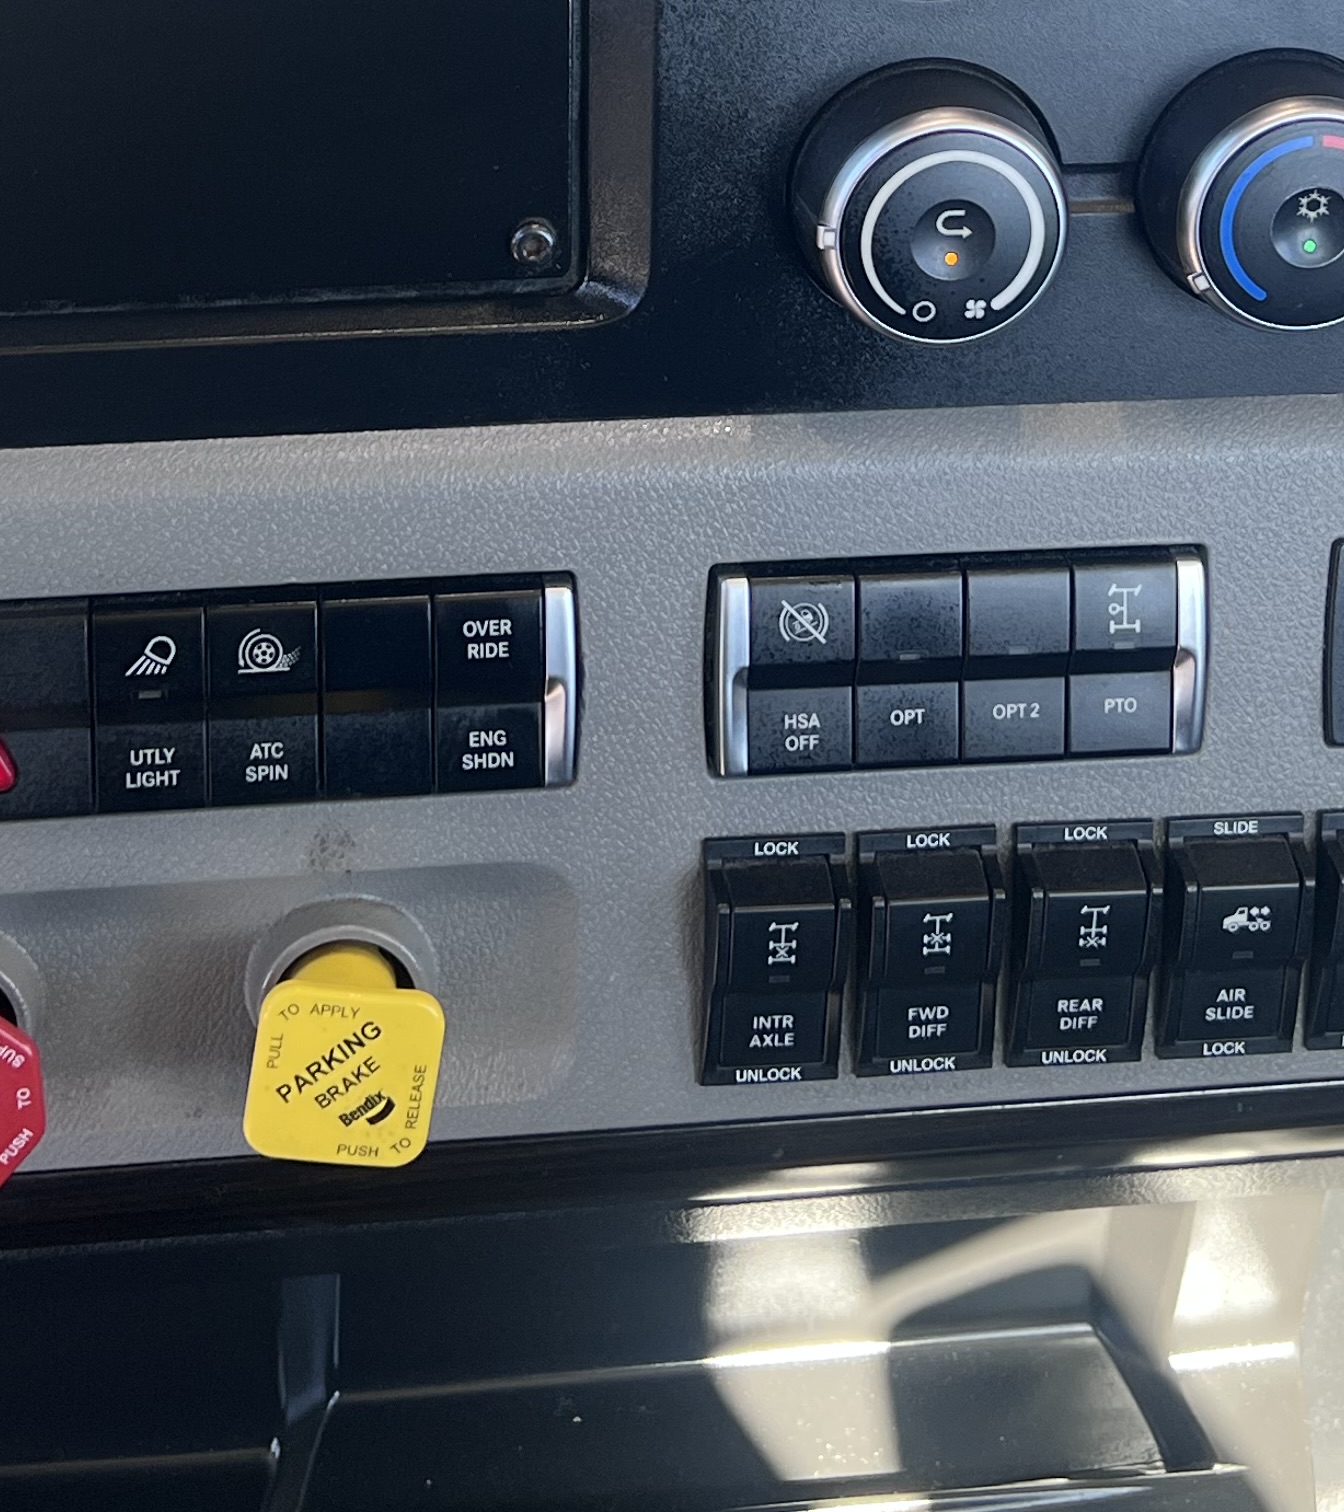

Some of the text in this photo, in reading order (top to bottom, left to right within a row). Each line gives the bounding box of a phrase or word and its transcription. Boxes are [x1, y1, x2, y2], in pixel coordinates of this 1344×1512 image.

[462, 619, 512, 638] OVER
[466, 641, 509, 660] RIDE
[992, 702, 1040, 720] OPT 2
[1104, 697, 1137, 714] PTO
[784, 713, 820, 730] HSA
[889, 709, 925, 726] OPT
[468, 730, 507, 749] ENG
[785, 734, 819, 752] OFF
[130, 747, 176, 766] UTLY
[249, 742, 284, 760] ATC
[461, 751, 514, 770] SHDN
[125, 769, 180, 788] LIGHT
[245, 764, 288, 782] SPIN
[1064, 826, 1107, 841] LOCK
[1213, 820, 1259, 835] SLIDE
[754, 841, 799, 856] LOCK
[906, 832, 951, 848] LOCK
[1216, 988, 1246, 1003] AIR
[908, 1005, 949, 1021] FWD
[1057, 998, 1103, 1013] REAR
[1205, 1005, 1254, 1021] SLIDE
[753, 1014, 794, 1030] INTR
[1060, 1016, 1097, 1030] DIFF
[267, 1003, 360, 1069] PULL TO APPLY
[908, 1023, 947, 1039] DIFF
[749, 1032, 794, 1048] AXLE
[1042, 1049, 1107, 1064] UNLOCK
[1203, 1042, 1245, 1056] LOCK
[275, 1021, 382, 1104] PARKING
[890, 1057, 955, 1073] UNLOCK
[314, 1056, 380, 1109] BRAKE
[735, 1066, 802, 1083] UNLOCK
[17, 1088, 32, 1110] TO
[336, 1064, 427, 1157] PUSH TO RELEASE
[338, 1089, 386, 1128] Bendix
